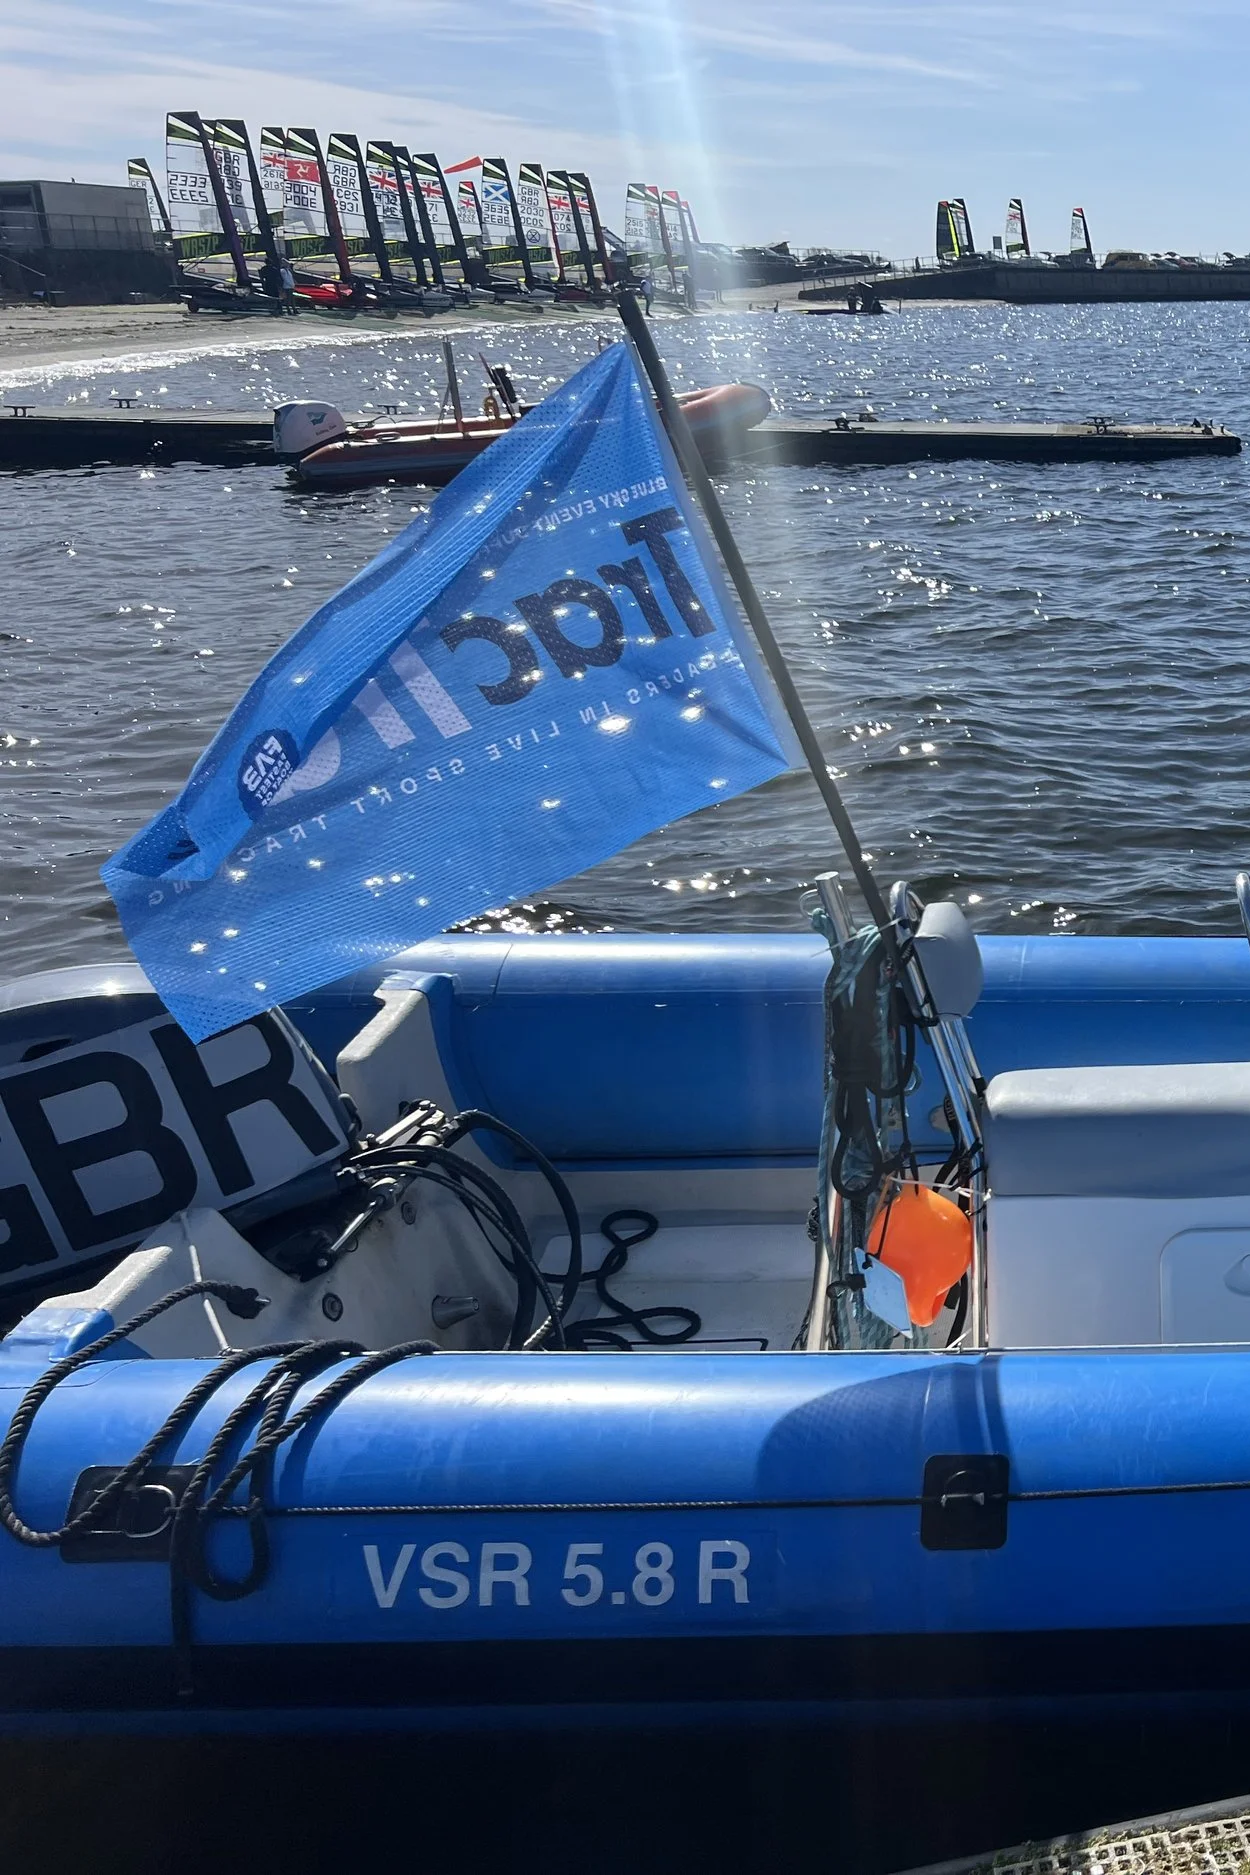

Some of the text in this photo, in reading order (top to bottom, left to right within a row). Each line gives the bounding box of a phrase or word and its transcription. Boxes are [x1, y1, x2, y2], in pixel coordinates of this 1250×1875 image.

[169, 174, 207, 188] 2333
[333, 176, 356, 188] GBR
[285, 182, 317, 196] 3004
[521, 186, 539, 198] GBR
[520, 206, 544, 217] 2030
[554, 213, 571, 222] 074
[363, 1540, 750, 1609] VSR 5.8 R
